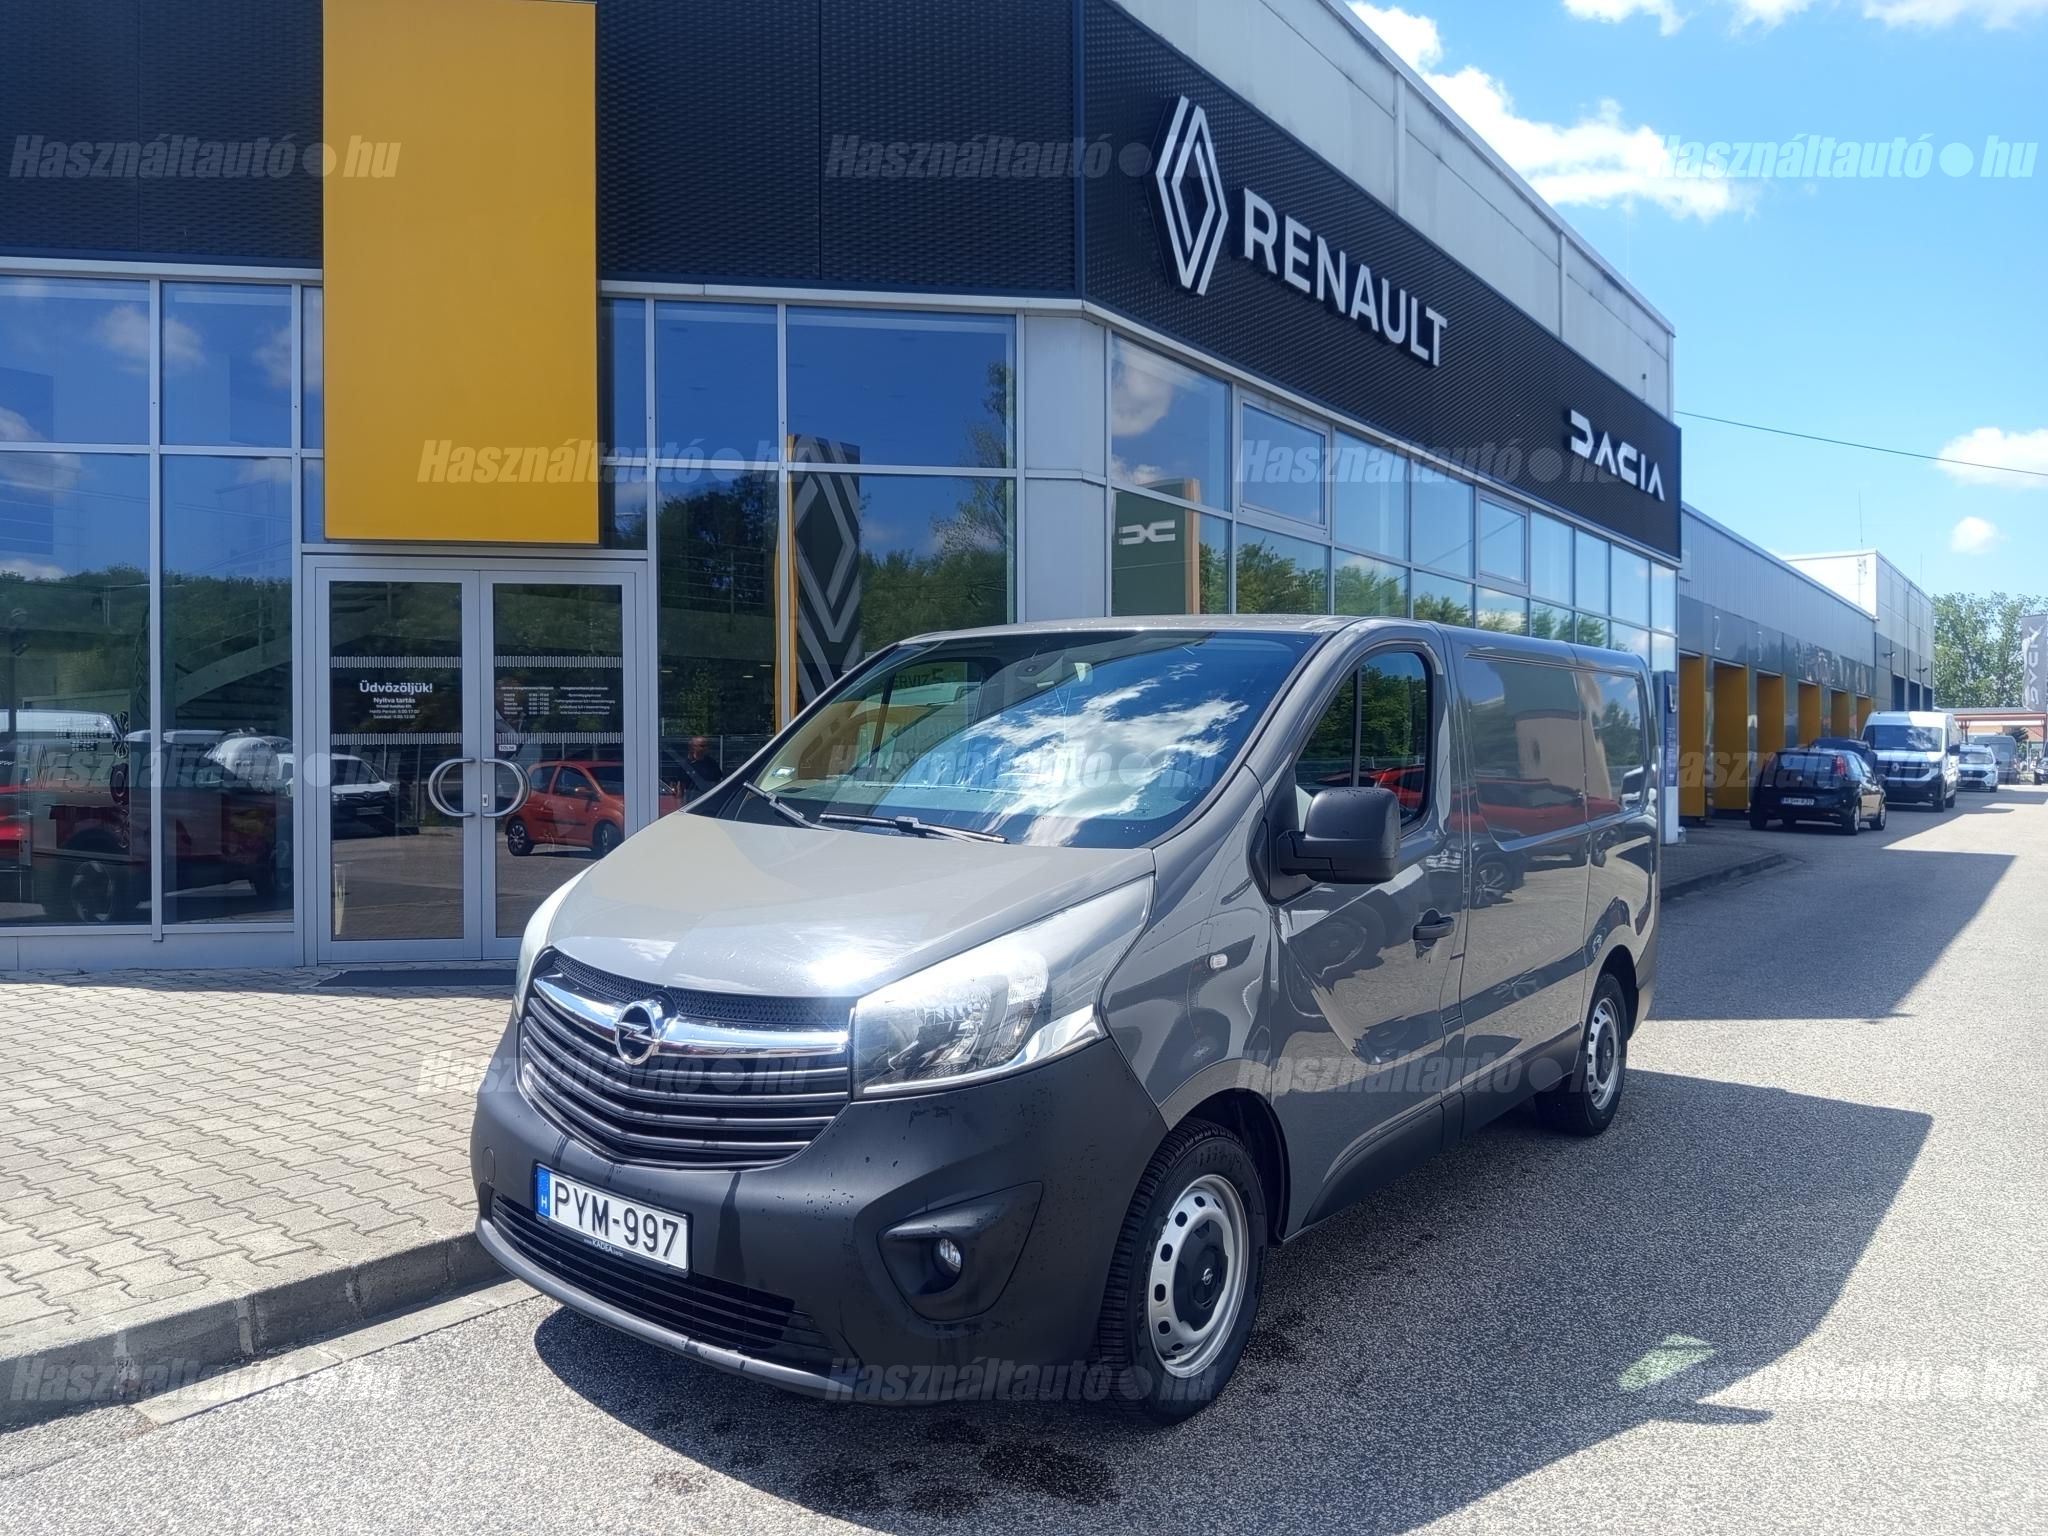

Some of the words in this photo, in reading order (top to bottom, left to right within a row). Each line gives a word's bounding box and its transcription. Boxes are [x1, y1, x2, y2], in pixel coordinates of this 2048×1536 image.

[1244, 187, 1449, 367] RENAULT
[1569, 408, 1665, 502] DACIA
[359, 679, 433, 696] Üdvözöljük!
[373, 697, 395, 705] Nyitva
[540, 1194, 548, 1209] H
[555, 1180, 679, 1257] PYM-997
